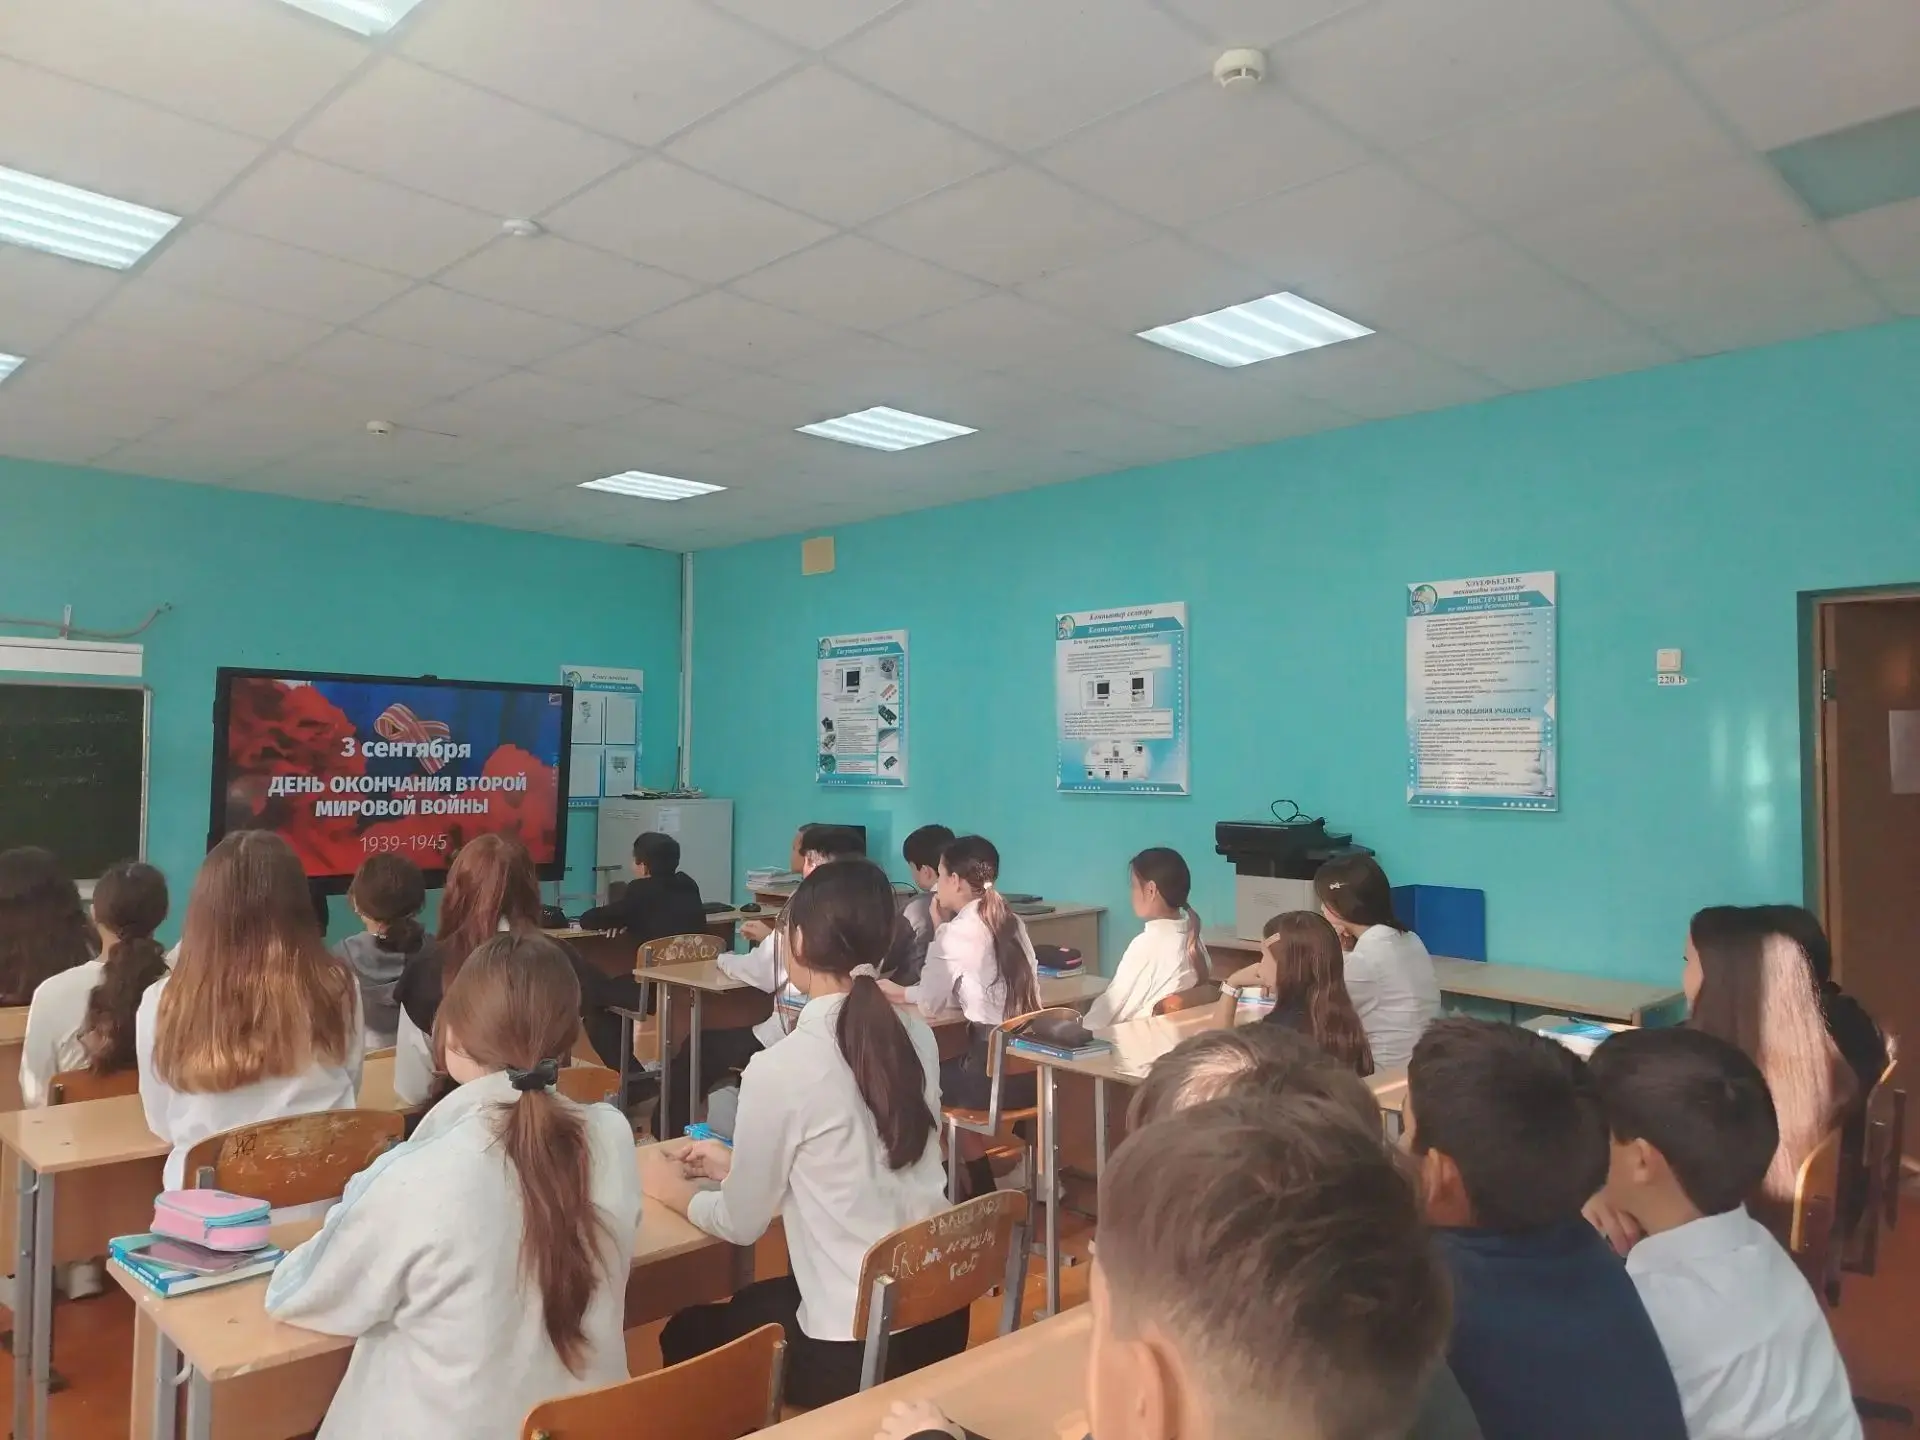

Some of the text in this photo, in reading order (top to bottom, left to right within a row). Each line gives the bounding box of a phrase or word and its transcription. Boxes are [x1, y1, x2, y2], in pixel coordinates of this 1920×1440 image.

[1658, 675, 1675, 685] 220
[340, 736, 471, 763] 3 сентября
[268, 772, 528, 797] ДЕНЬ ОКОНЧАНИЯ ВТОРОЙ
[315, 794, 489, 817] МИРОВОЙ ВОЙНЫ
[359, 833, 448, 853] 1939-1945
